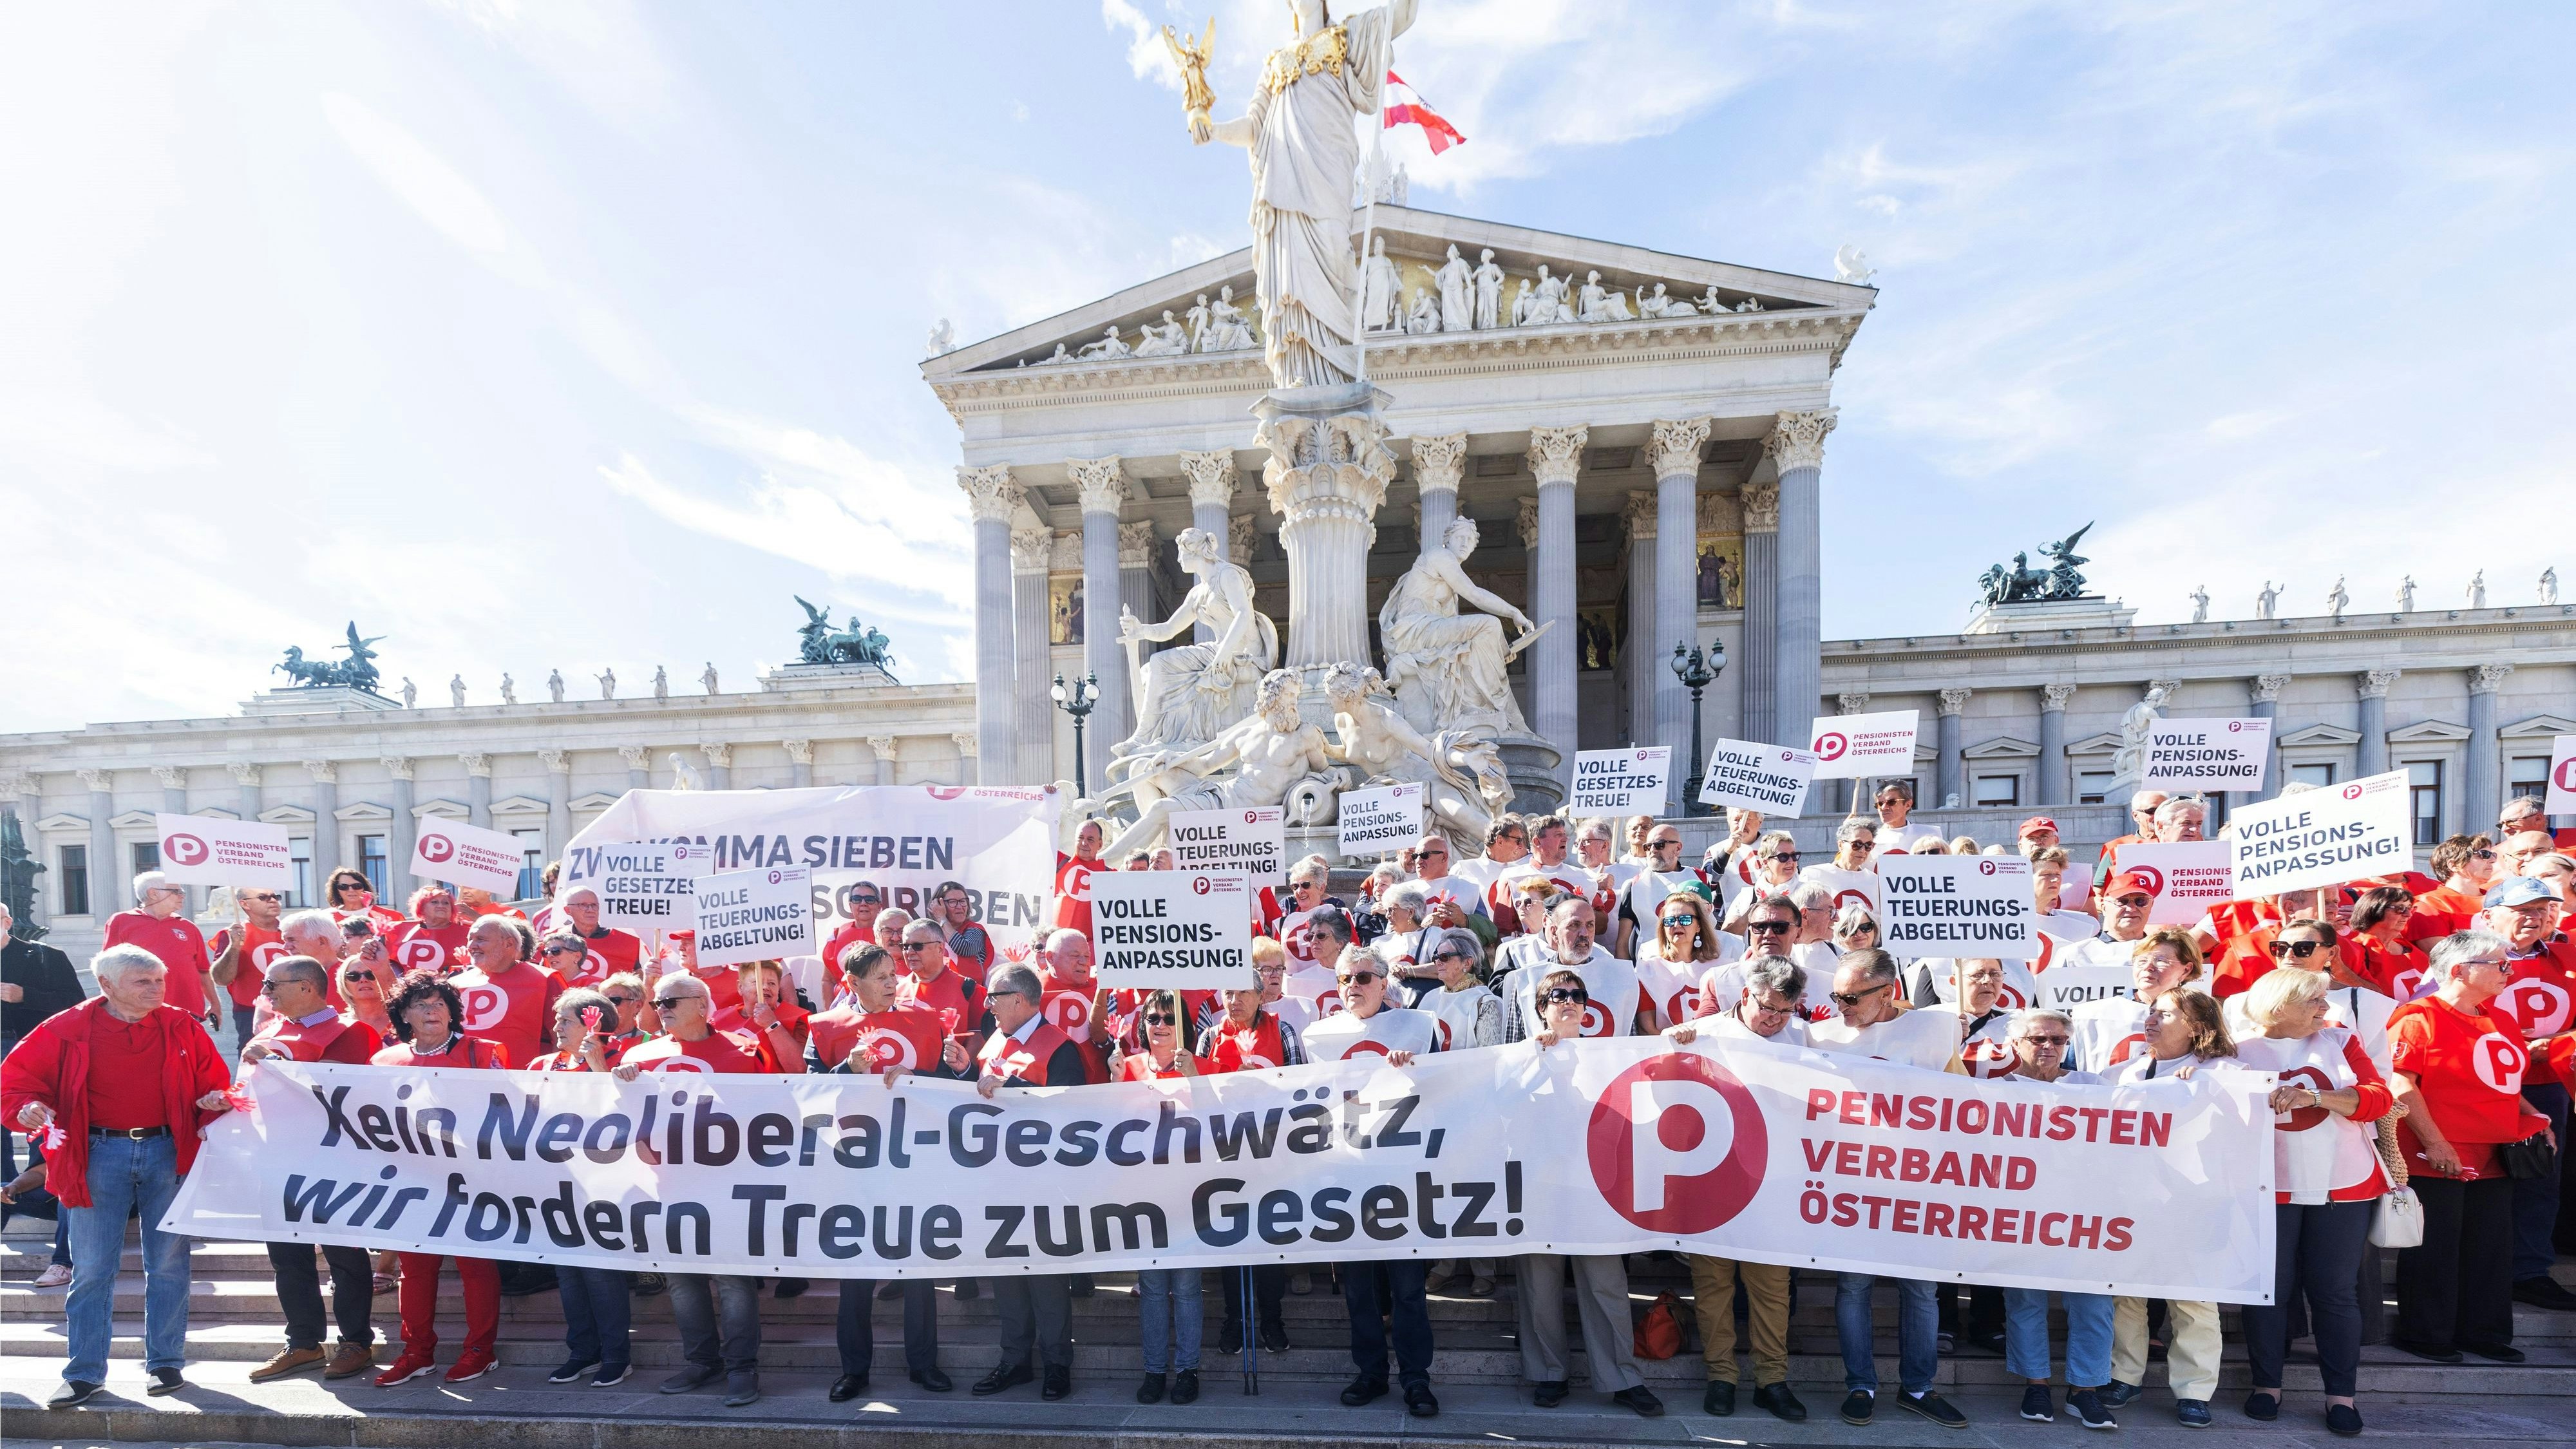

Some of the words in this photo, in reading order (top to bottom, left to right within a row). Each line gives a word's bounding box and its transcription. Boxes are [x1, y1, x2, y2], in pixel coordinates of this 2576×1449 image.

[1853, 730, 1913, 740] PENSIONISTEN
[2154, 734, 2206, 746] VOLLE
[1718, 751, 1762, 768] VOLLE
[1852, 747, 1908, 756] ÖSTERREICHS
[2152, 749, 2245, 762] PENSIONS-
[1578, 759, 1628, 774] VOLLE
[2148, 764, 2258, 777] ANPASSUNG!
[1577, 775, 1663, 791] GESETZES-
[1713, 765, 1803, 790] TEUERUNGS-
[974, 789, 1045, 801] ÖSTERREICHS
[1575, 793, 1630, 808] TREUE!
[1706, 780, 1795, 806] ABGELTUNG!
[1343, 800, 1379, 815] VOLLE
[1343, 811, 1407, 829] PENSIONS-
[2239, 811, 2312, 840] VOLLE
[1174, 826, 1227, 842] VOLLE
[1343, 824, 1417, 843] ANPASSUNG!
[2240, 822, 2374, 861] PENSIONS-
[215, 840, 288, 853] PENSIONISTEN
[216, 849, 264, 858] VERBAND
[461, 844, 521, 864] PENSIONISTEN
[802, 835, 954, 871] SIEBEN
[1176, 841, 1280, 860] TEUERUNGS-
[218, 856, 285, 869] ÖSTERREICHS
[460, 851, 498, 866] VERBAND
[607, 856, 665, 873] VOLLE
[2240, 836, 2400, 882] ANPASSUNG!
[458, 858, 513, 877] ÖSTERREICHS
[2172, 867, 2231, 876] PENSIONIS
[1886, 876, 1956, 893] VOLLE
[2172, 878, 2224, 887] VERBAND
[698, 888, 748, 909] VOLLE
[2171, 888, 2233, 897] ÖSTERREIC
[605, 898, 670, 915] TREUE!
[1098, 898, 1167, 919] VOLLE
[1888, 899, 2029, 916] TEUERUNGS-
[699, 903, 806, 930] TEUERUNGS-
[701, 923, 804, 951] ABGELTUNG!
[1101, 923, 1222, 944] PENSIONS-
[1889, 923, 2025, 940] ABGELTUNG!
[1103, 949, 1244, 969] ANPASSUNG!
[311, 1084, 457, 1158] Kein
[477, 1086, 1446, 1169] Neoliberal-Geschwätz,
[1806, 1088, 2173, 1148] PENSIONISTEN
[1801, 1139, 2036, 1190] VERBAND
[283, 1164, 429, 1230] wir
[428, 1172, 711, 1256] fordern
[731, 1184, 963, 1260] Treue
[985, 1202, 1169, 1258] zum
[1191, 1160, 1524, 1247] Gesetz!
[1800, 1180, 2135, 1251] ÖSTERREICHS
